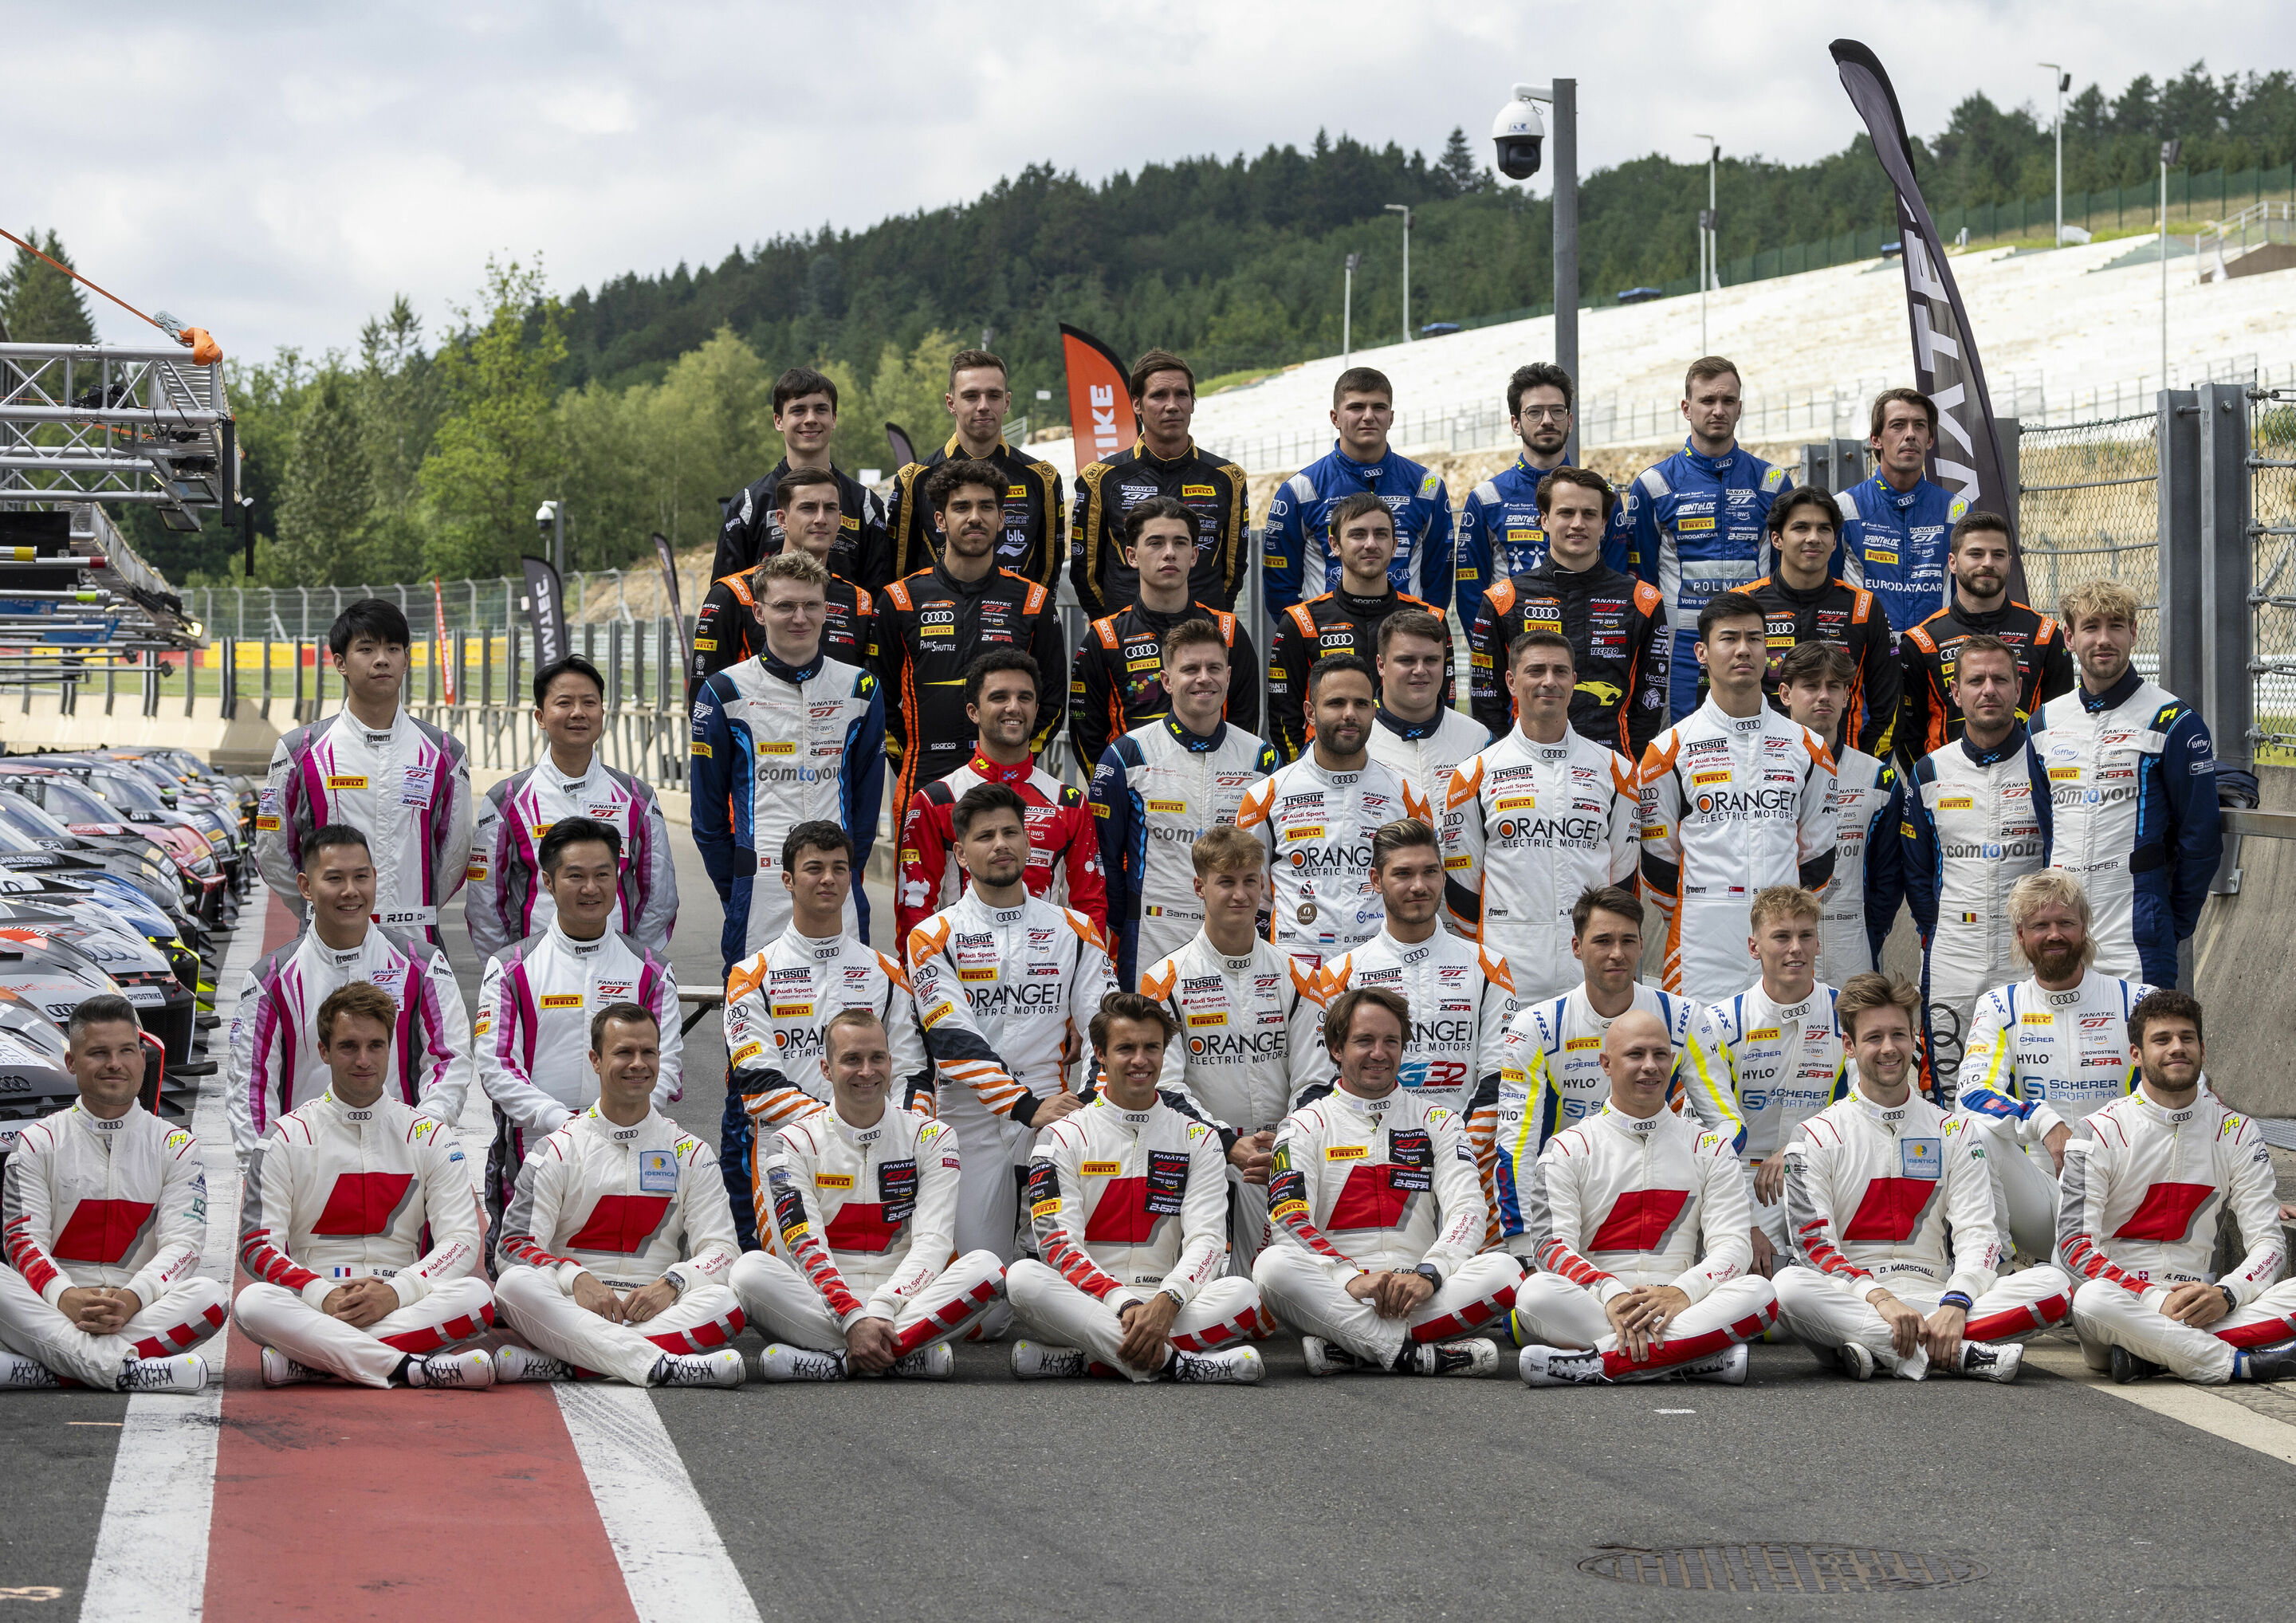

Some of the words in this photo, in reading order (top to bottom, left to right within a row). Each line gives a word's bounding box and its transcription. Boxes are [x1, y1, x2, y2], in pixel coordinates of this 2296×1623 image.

[1090, 384, 1119, 462] IKE
[1768, 470, 1781, 483] P1
[1425, 477, 1436, 492] P1
[1952, 502, 1964, 517] P1
[1681, 521, 1712, 530] PIRELLI
[729, 577, 751, 602] sparco
[1865, 579, 1944, 595] EURODATACAR
[890, 583, 906, 604] sparco
[1029, 584, 1044, 608] sparco
[1857, 592, 1869, 617] sparco
[1293, 608, 1314, 631] sparco
[1099, 619, 1115, 643] sparco
[1590, 647, 1619, 656] TECPRO
[1130, 661, 1158, 670] PIRELLI
[861, 675, 874, 693] P1
[2159, 707, 2177, 723] P1
[367, 733, 391, 742] freem
[761, 744, 793, 754] PIRELLI
[1686, 739, 1728, 753] Tresor
[1264, 749, 1276, 766] P1
[2054, 749, 2076, 758] löffler
[60, 767, 127, 781] ATEC
[758, 765, 842, 785] comtoyou
[1492, 767, 1533, 780] Tresor
[1696, 772, 1728, 784] PIRELLI
[1883, 768, 1894, 783] P1
[5, 774, 83, 790] ATEC
[331, 777, 364, 787] PIRELLI
[1283, 792, 1325, 805] Tresor
[1696, 788, 1797, 815] ORANGE1
[2053, 785, 2138, 807] comtoyou
[1150, 802, 1183, 812] PIRELLI
[1500, 799, 1531, 809] PIRELLI
[1939, 800, 1970, 809] PIRELLI
[1700, 812, 1748, 823] ELECTRIC
[1754, 810, 1794, 820] MOTORS
[1289, 828, 1321, 839] PIRELLI
[1498, 818, 1602, 843] ORANGE1
[1501, 839, 1553, 848] ELECTRIC
[1559, 839, 1598, 850] MOTORS
[1946, 842, 2036, 863] comtoyou
[2083, 860, 2119, 872] HOFER
[1292, 867, 1341, 878] ELECTRIC
[1685, 885, 1707, 894] freem
[387, 913, 413, 922] RIO
[1166, 910, 1189, 919] Sam
[1488, 908, 1508, 918] freem
[1278, 930, 1295, 940] freem
[575, 943, 600, 955] freem
[336, 952, 360, 964] freem
[769, 968, 811, 980] Tresor
[961, 970, 993, 980] PIRELLI
[1359, 969, 1402, 981] Tresor
[1181, 976, 1222, 988] Tresor
[128, 992, 163, 1003] OWDSTRIKE
[776, 1006, 809, 1016] PIRELLI
[1014, 1004, 1060, 1016] MOTORS
[1191, 1014, 1224, 1025] PIRELLI
[1412, 1020, 1473, 1043] NGE1
[1188, 1031, 1287, 1055] ORANGE
[1428, 1042, 1472, 1051] MOTORS
[784, 1046, 824, 1060] ECTRIC
[1190, 1055, 1244, 1066] ELECTRIC
[1252, 1050, 1289, 1064] MOTORS
[1743, 1051, 1782, 1062] SCHERER
[2015, 1053, 2050, 1064] HYLO
[1741, 1069, 1775, 1081] HYLO
[1564, 1077, 1596, 1090] HYLO
[2049, 1079, 2118, 1091] SCHERER
[1771, 1088, 1830, 1100] SCHERER
[2050, 1090, 2092, 1101] SPORT
[2095, 1090, 2119, 1099] PHX
[1767, 1097, 1805, 1110] SPORT
[1807, 1099, 1828, 1110] PHX
[1879, 1266, 1889, 1275] D.
[1890, 1263, 1935, 1279] MARSCHALL
